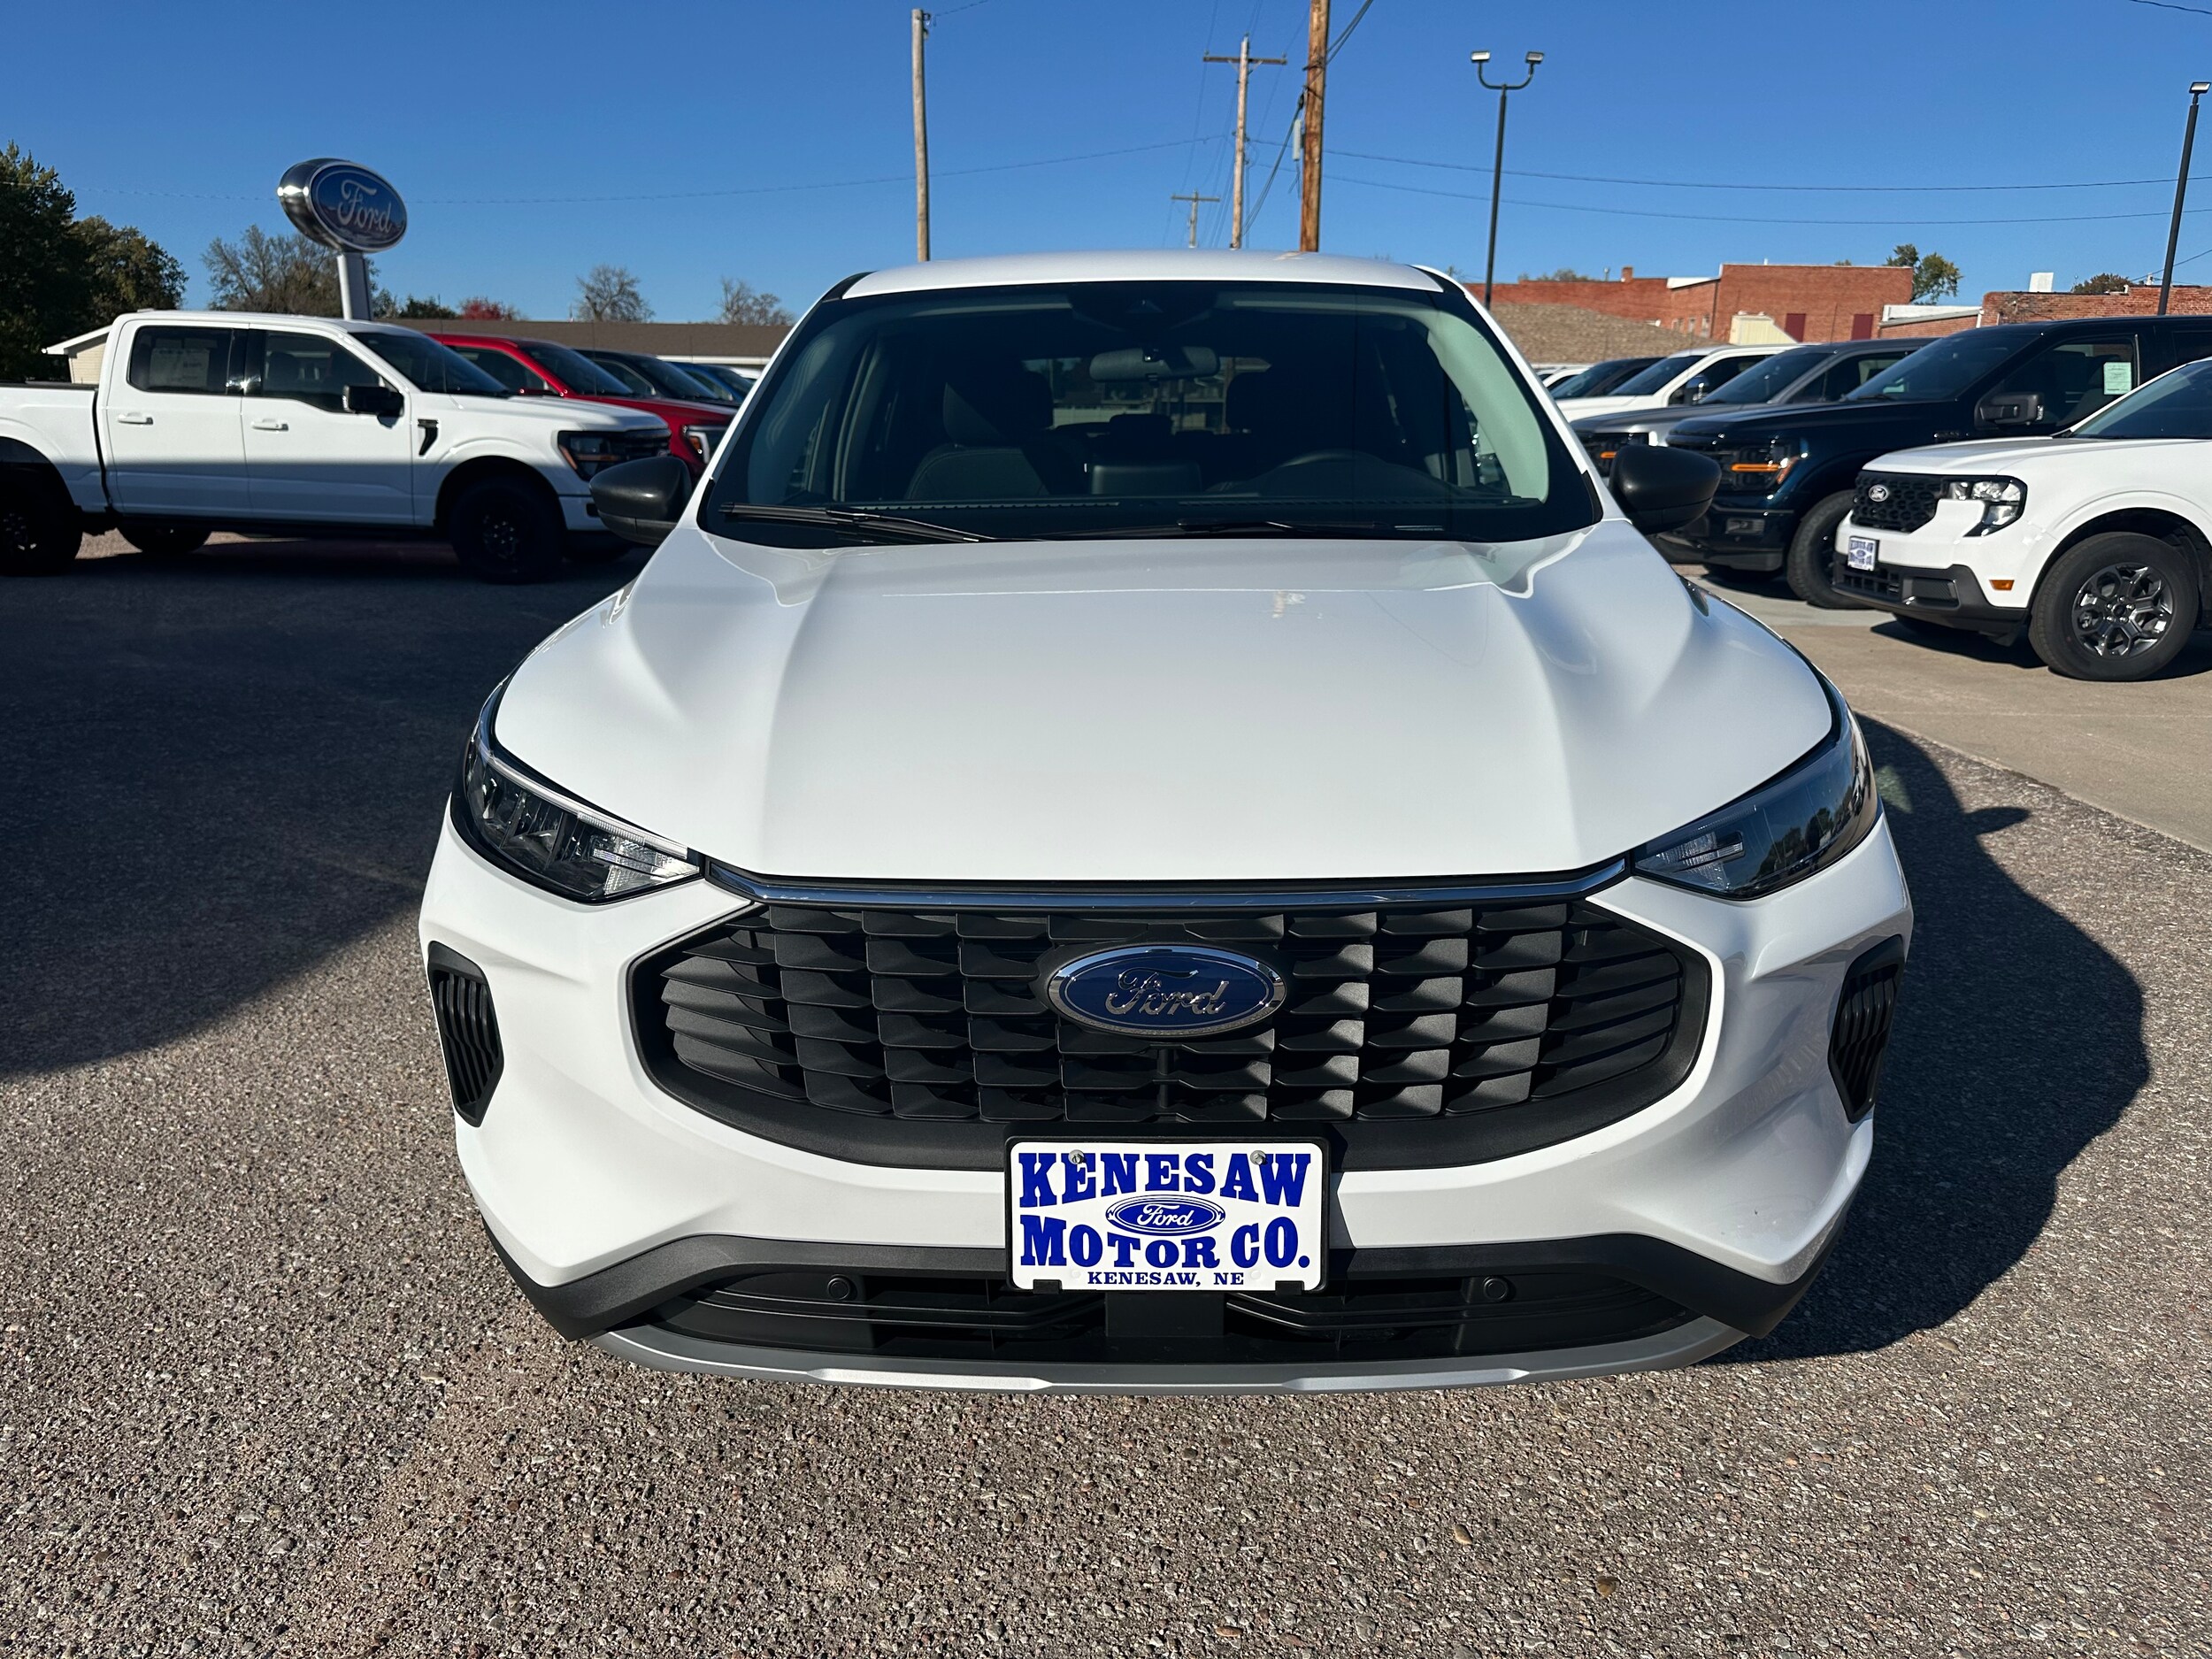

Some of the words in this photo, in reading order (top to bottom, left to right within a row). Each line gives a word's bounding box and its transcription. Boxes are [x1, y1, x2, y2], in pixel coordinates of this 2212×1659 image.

[337, 180, 392, 233] Ford
[1105, 967, 1229, 1015] Ford
[1018, 1152, 1311, 1208] KENESAW
[1136, 1204, 1194, 1226] Ford
[1020, 1214, 1220, 1268] MOTOR
[1230, 1216, 1310, 1268] CO.
[1087, 1271, 1201, 1287] KENESAW,
[1214, 1272, 1244, 1286] NE
